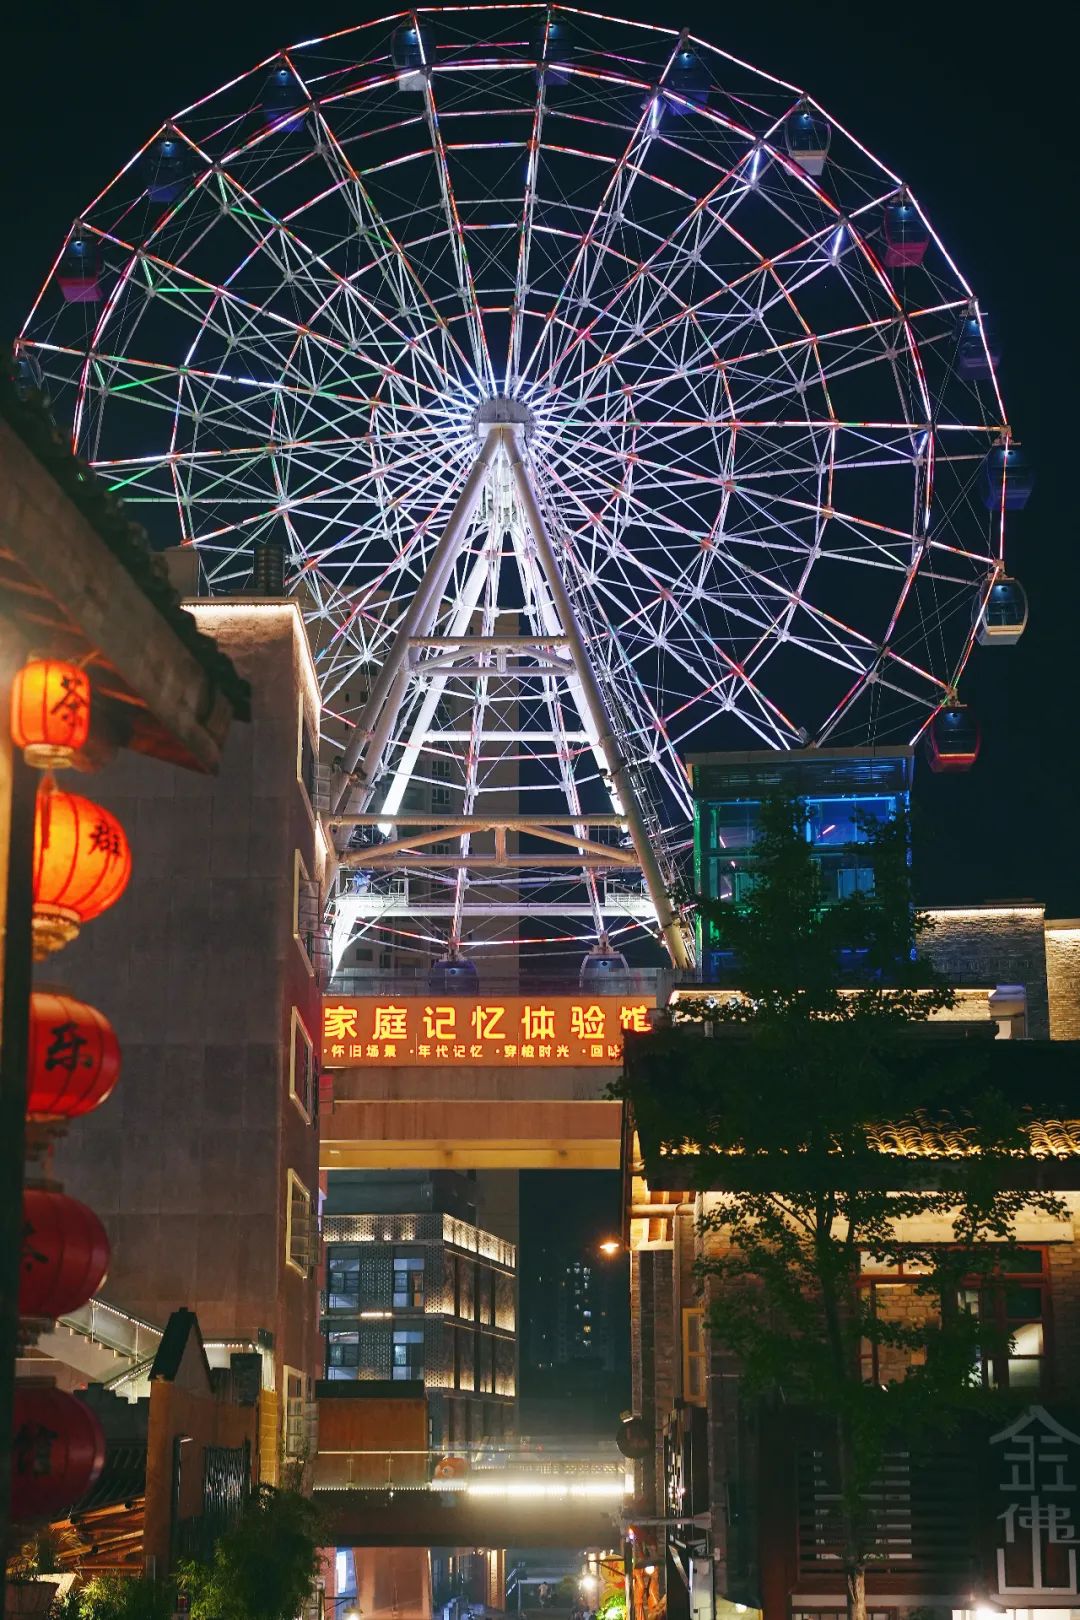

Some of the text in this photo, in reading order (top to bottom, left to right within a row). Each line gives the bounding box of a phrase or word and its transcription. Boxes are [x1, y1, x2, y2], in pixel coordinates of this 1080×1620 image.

[324, 1005, 652, 1040] 家庭记忆体验馆
